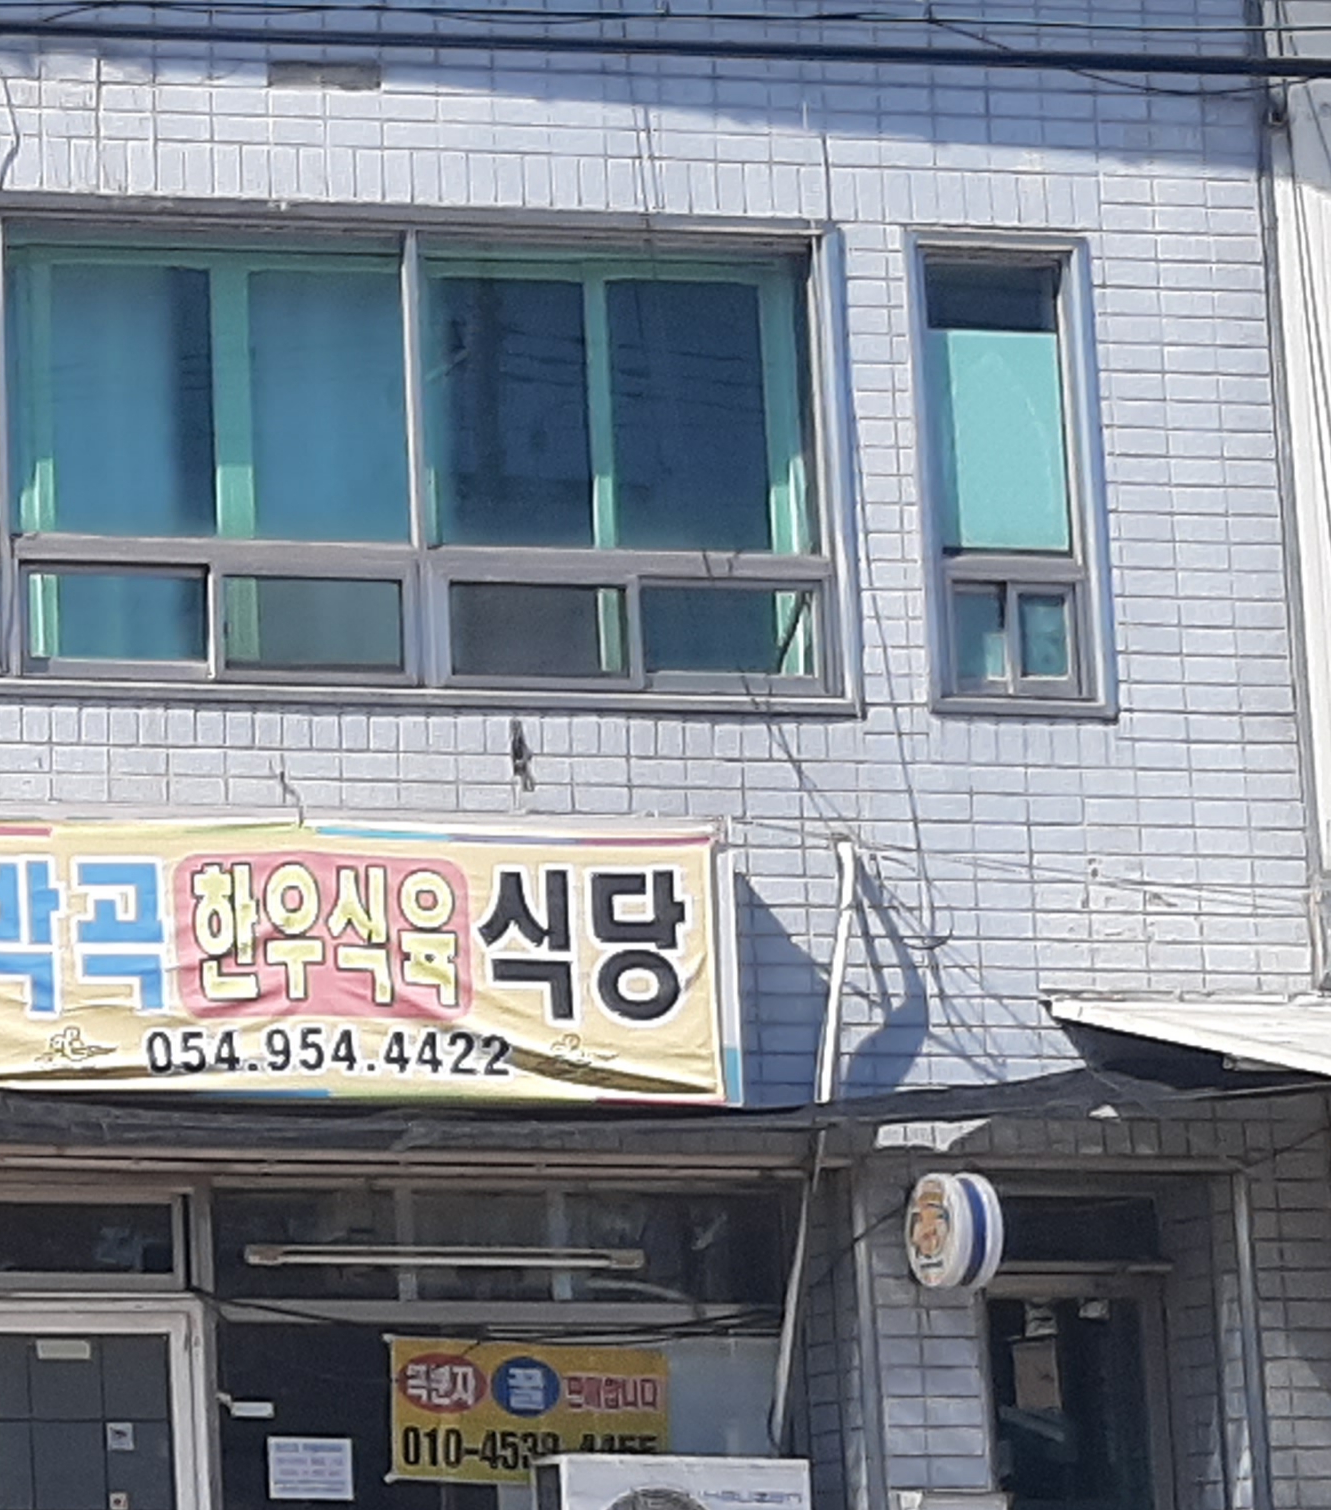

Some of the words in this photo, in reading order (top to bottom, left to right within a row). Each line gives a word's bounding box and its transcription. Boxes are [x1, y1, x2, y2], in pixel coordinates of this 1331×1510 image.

[192, 860, 458, 1006] 한우식육
[477, 867, 688, 1023] 식당
[146, 1029, 512, 1078] 054.954.4422
